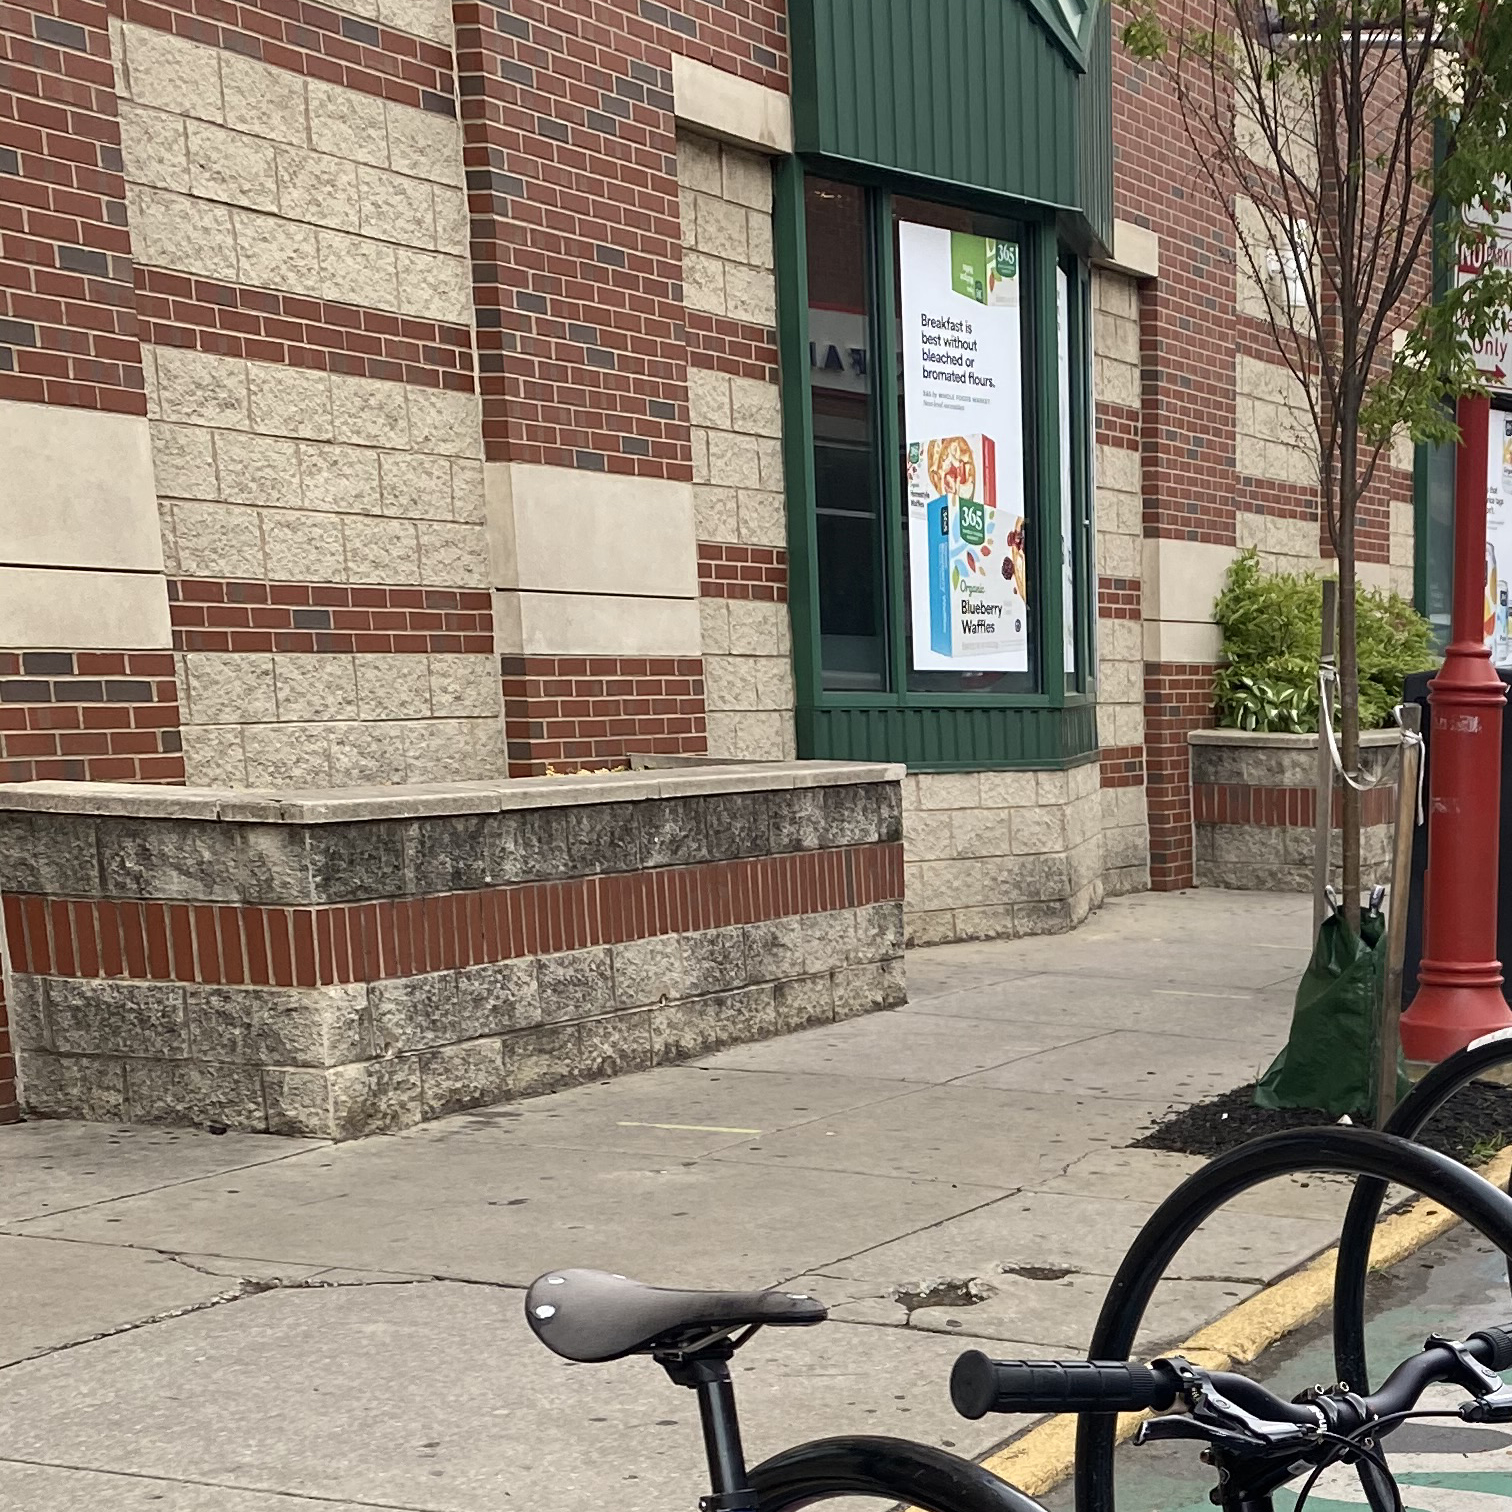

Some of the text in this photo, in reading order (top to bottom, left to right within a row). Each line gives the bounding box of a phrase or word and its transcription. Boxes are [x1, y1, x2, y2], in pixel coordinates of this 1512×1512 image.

[997, 243, 1015, 265] 365
[1460, 242, 1483, 268] NO
[921, 313, 973, 334] Breakfast is
[921, 330, 978, 352] best without
[1472, 336, 1508, 363] Only
[922, 347, 975, 368] bleached or
[922, 364, 996, 388] bromated flours.
[961, 506, 983, 530] 365
[960, 579, 985, 597] Organic
[961, 599, 1003, 619] Blueberry
[961, 619, 996, 634] Waffles
